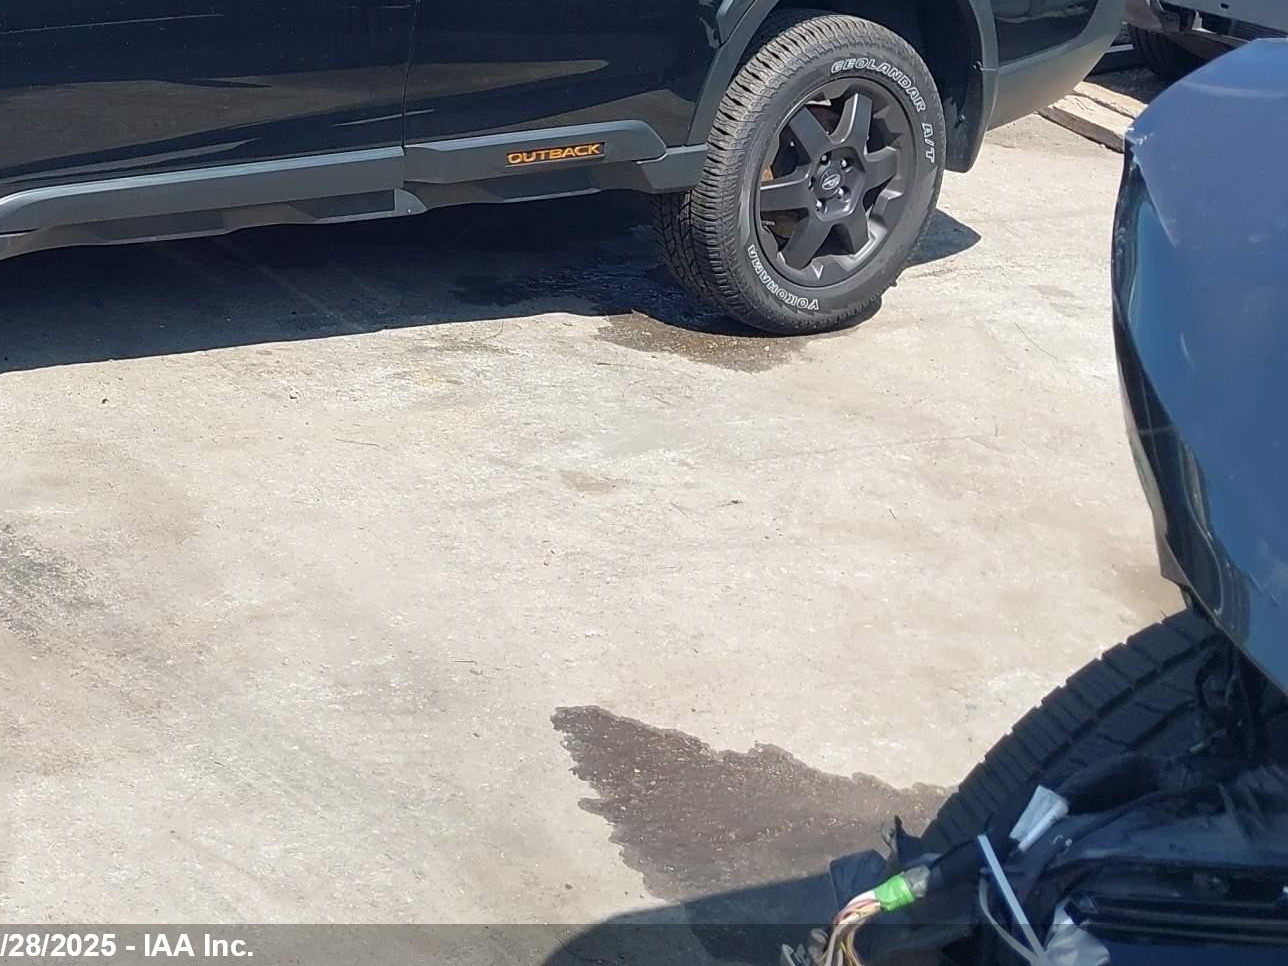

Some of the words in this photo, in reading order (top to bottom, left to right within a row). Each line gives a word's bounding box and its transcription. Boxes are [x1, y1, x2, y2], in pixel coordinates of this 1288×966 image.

[831, 58, 926, 113] GEOLANDAR
[922, 123, 935, 163] A/T
[507, 144, 601, 164] OUTBACK
[747, 244, 820, 310] YOKOHAMA
